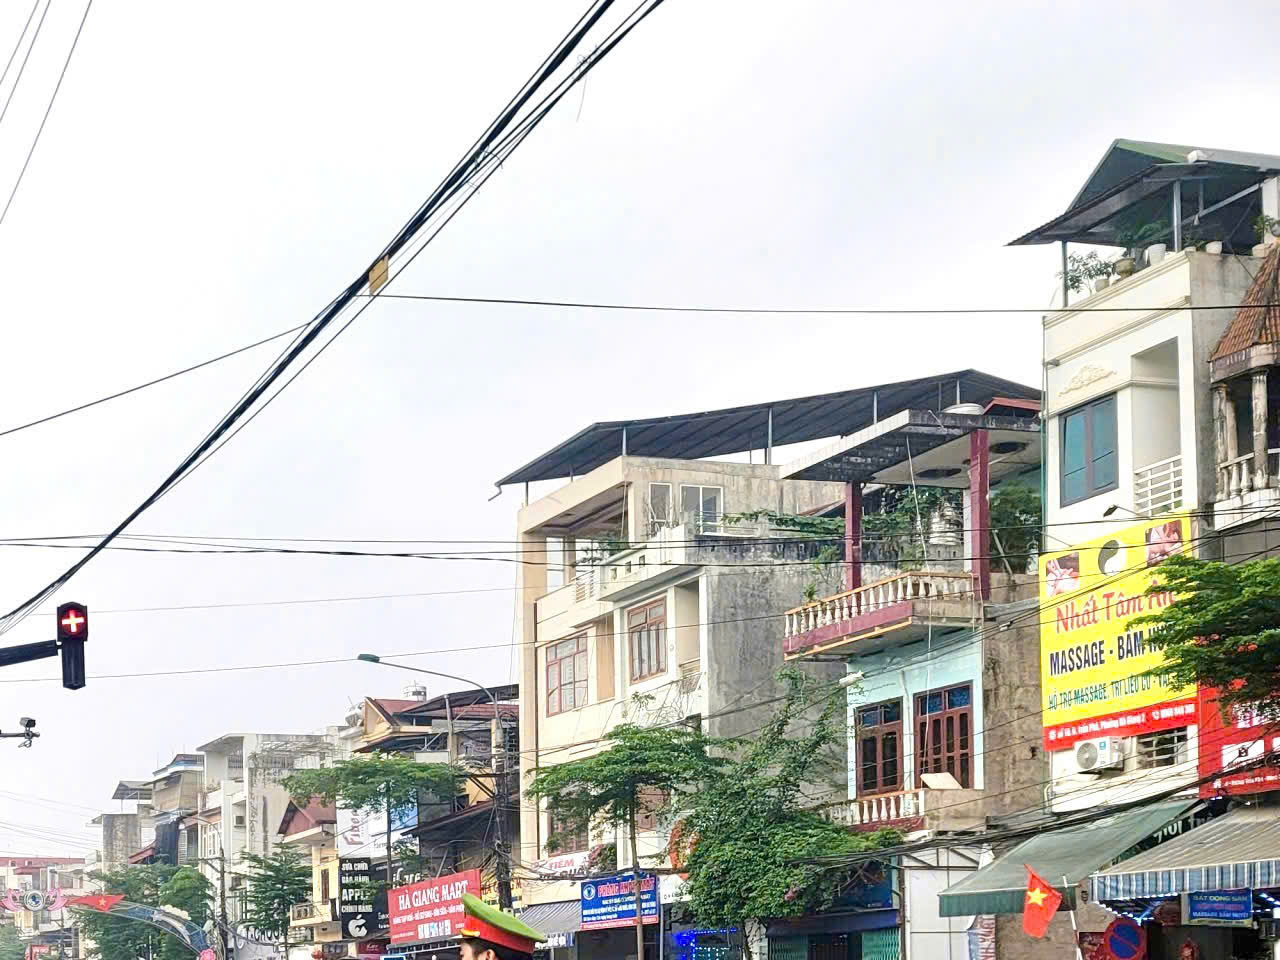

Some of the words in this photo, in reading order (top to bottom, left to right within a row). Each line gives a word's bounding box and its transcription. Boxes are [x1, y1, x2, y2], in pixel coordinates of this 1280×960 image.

[1056, 594, 1099, 634] Nhất
[1102, 591, 1144, 621] Tâm
[1049, 640, 1106, 676] MASSAGE
[398, 889, 411, 910] HÀ
[412, 885, 439, 908] GIANG
[441, 880, 469, 901] MART
